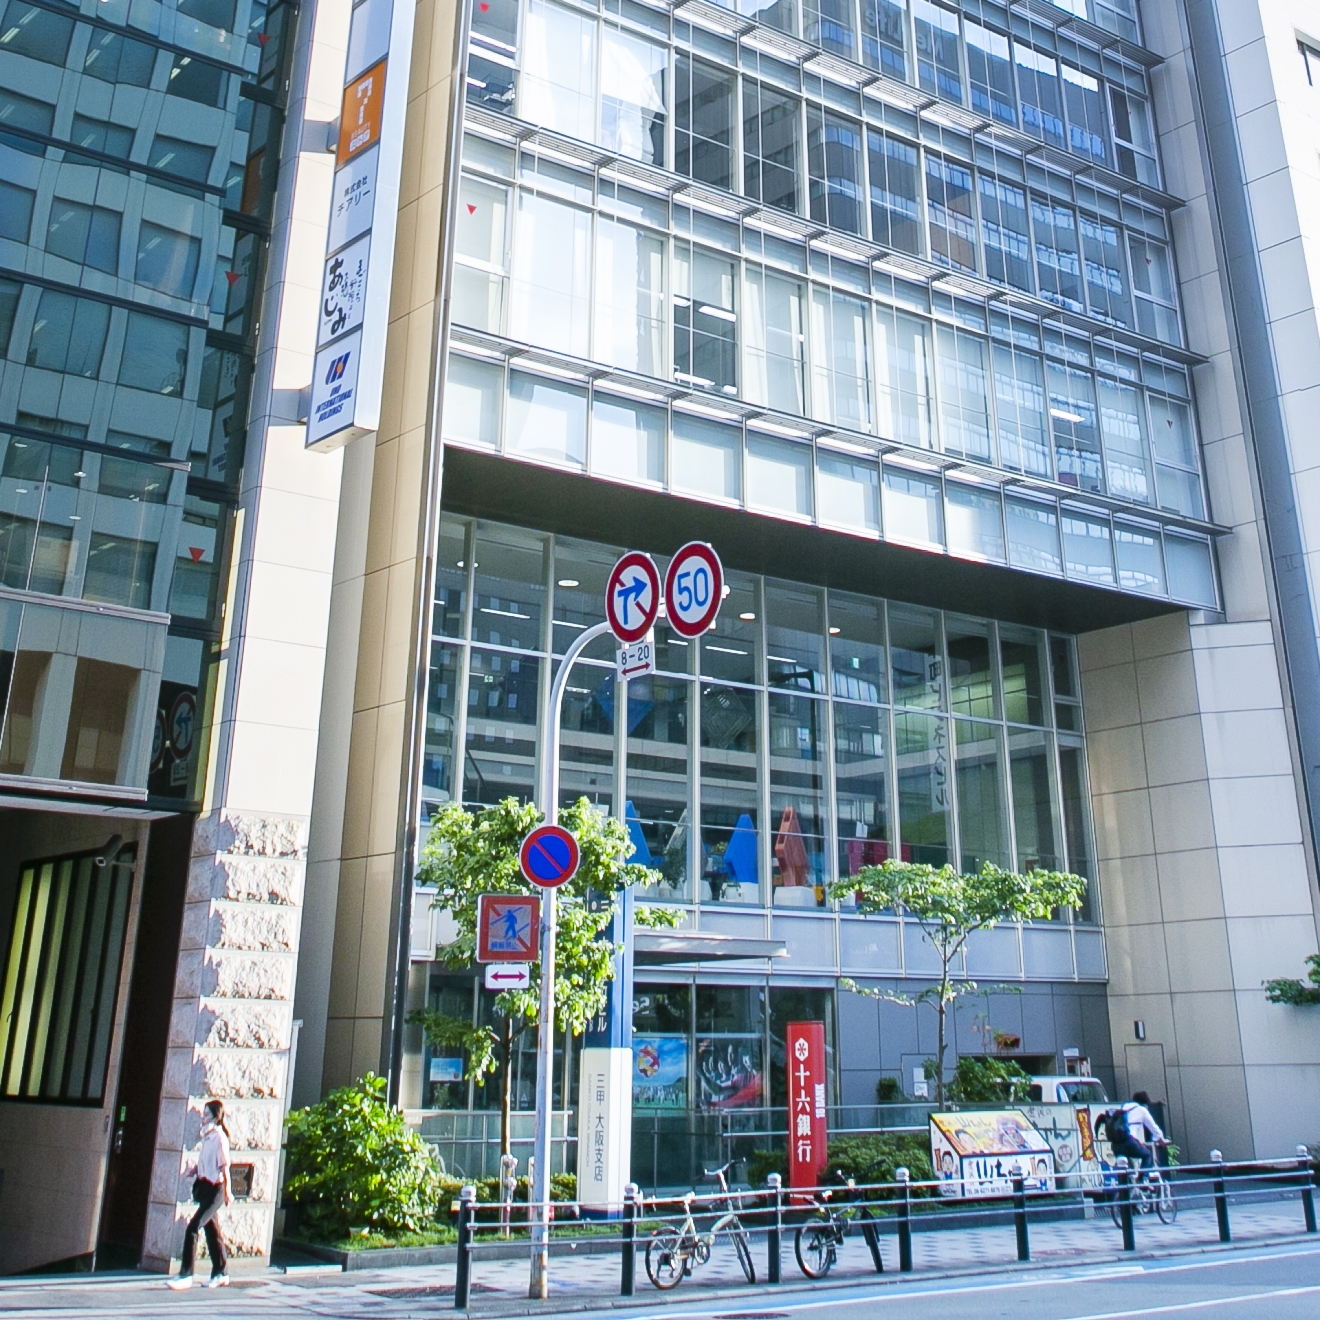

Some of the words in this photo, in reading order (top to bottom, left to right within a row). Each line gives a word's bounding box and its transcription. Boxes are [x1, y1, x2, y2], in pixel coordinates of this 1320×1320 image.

[337, 189, 371, 217] チアリー
[324, 257, 347, 335] あじみ
[677, 567, 709, 612] 50
[621, 645, 650, 665] 8-20
[595, 1073, 605, 1106] 三甲
[795, 1043, 812, 1163] 十六銀行
[593, 1112, 605, 1182] 大阪支店
